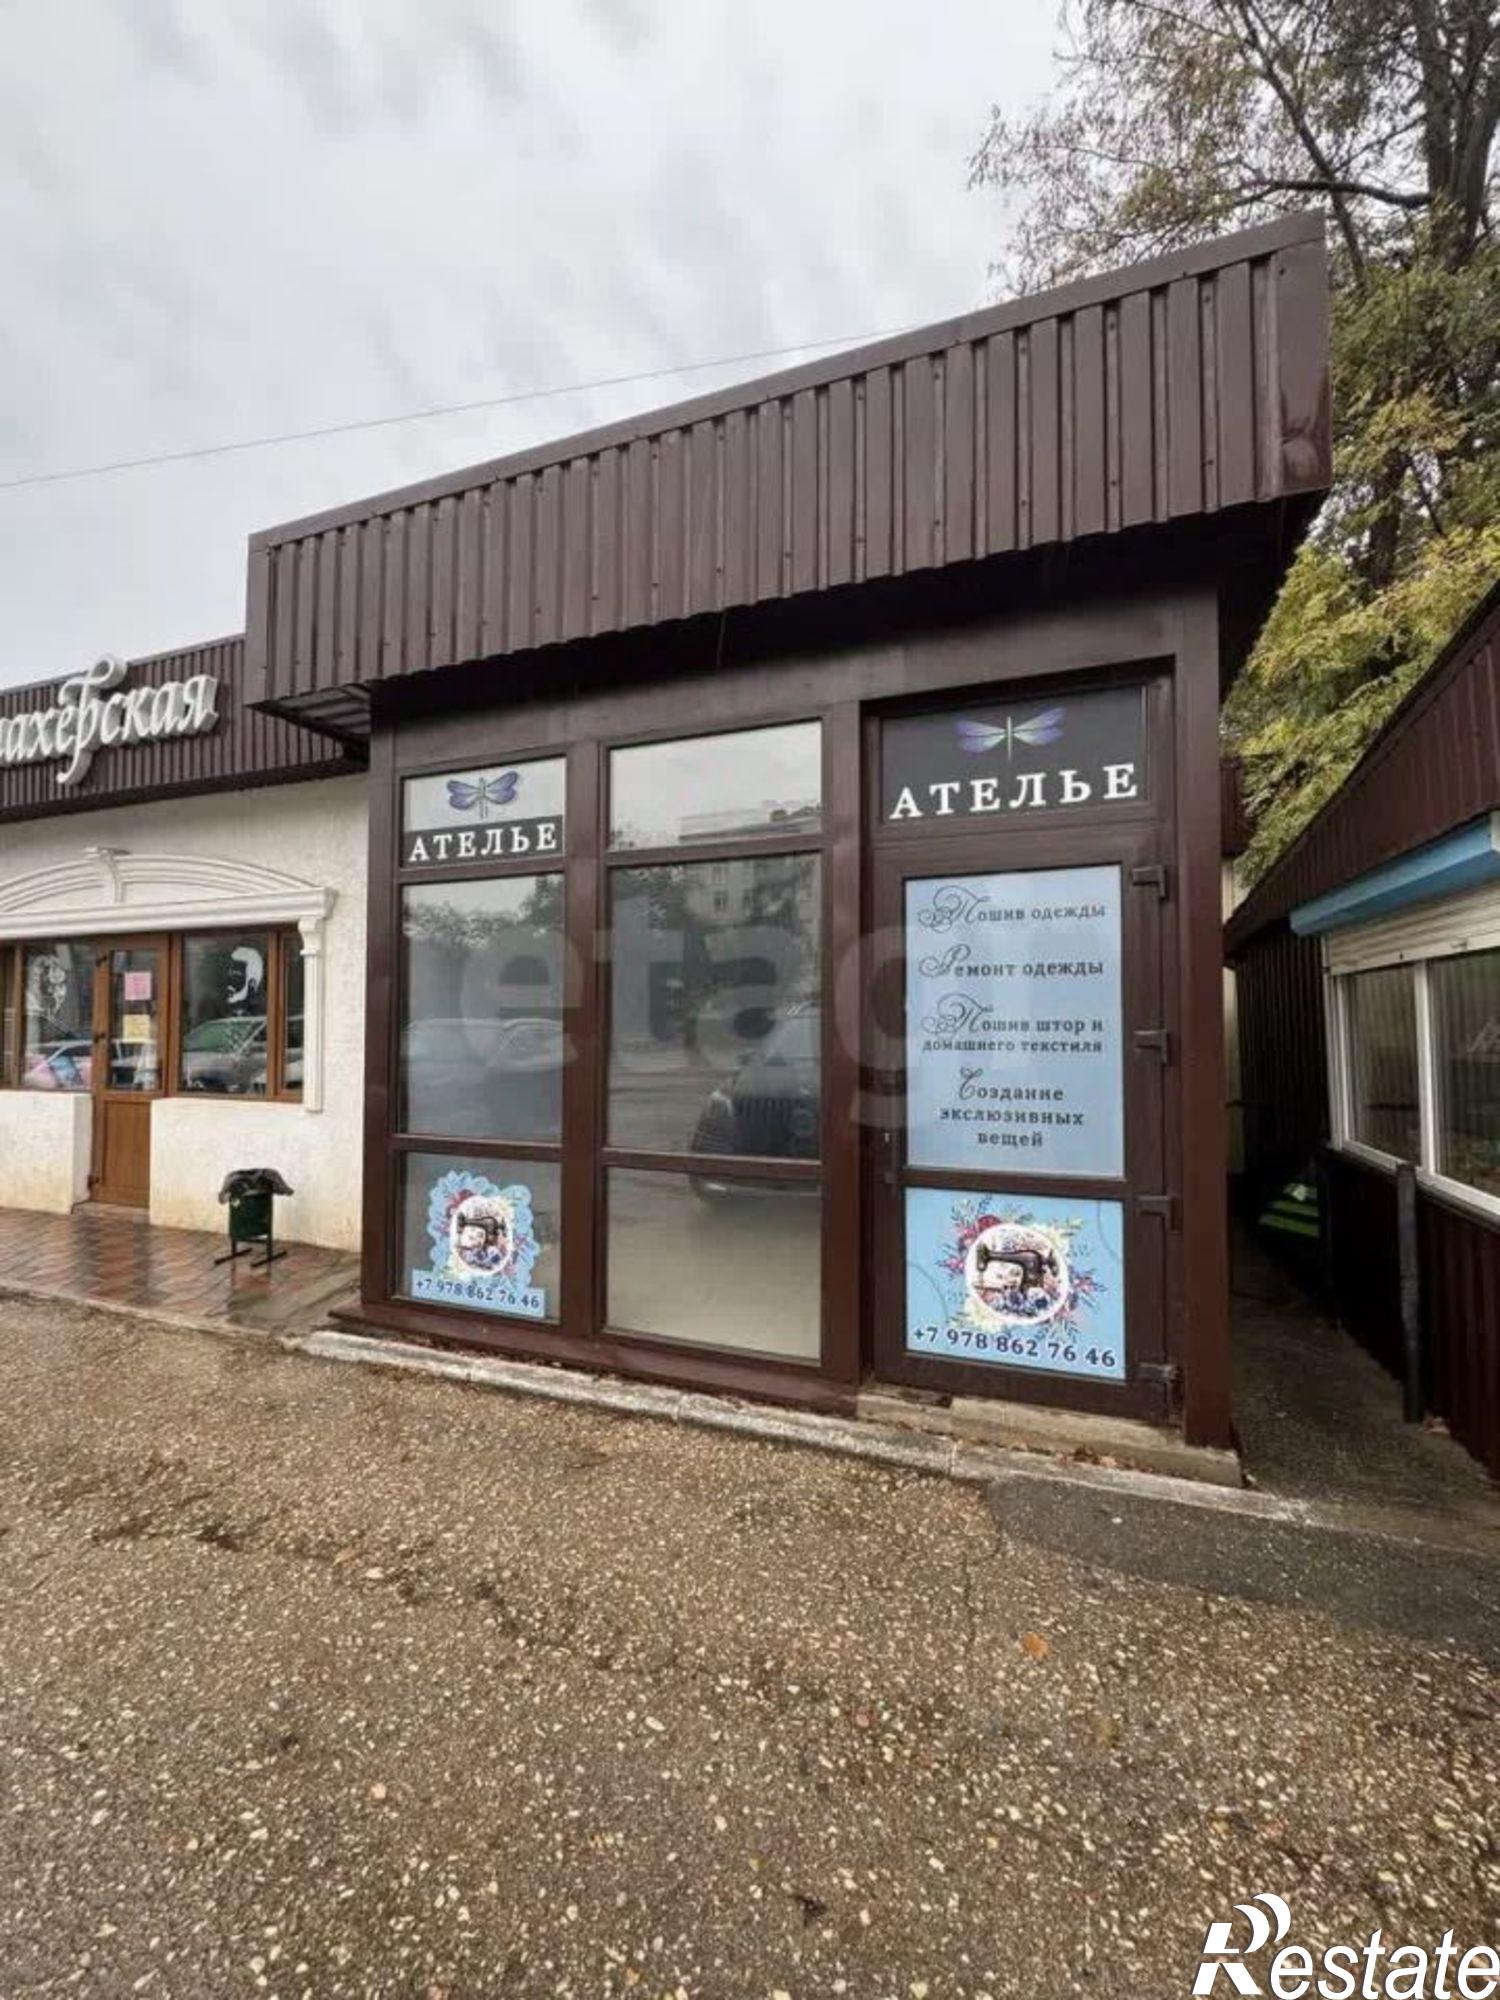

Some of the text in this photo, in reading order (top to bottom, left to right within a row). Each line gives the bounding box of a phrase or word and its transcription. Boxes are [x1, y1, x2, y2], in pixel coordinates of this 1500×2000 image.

[889, 763, 1138, 819] АТЕЛЬЕ
[409, 822, 557, 862] АТЕЛЬЕ
[918, 885, 1105, 933] Пошив одежды
[918, 943, 1103, 978] Ремонт одежды
[921, 992, 1103, 1035] Пошив штор и
[923, 1039, 1103, 1052] домашнего текстиля
[959, 1067, 1063, 1101] Создание
[978, 1131, 1043, 1148] вещей
[417, 1278, 539, 1309] +7 978 862 76 46
[913, 1327, 1116, 1368] +7 978 862 76 46
